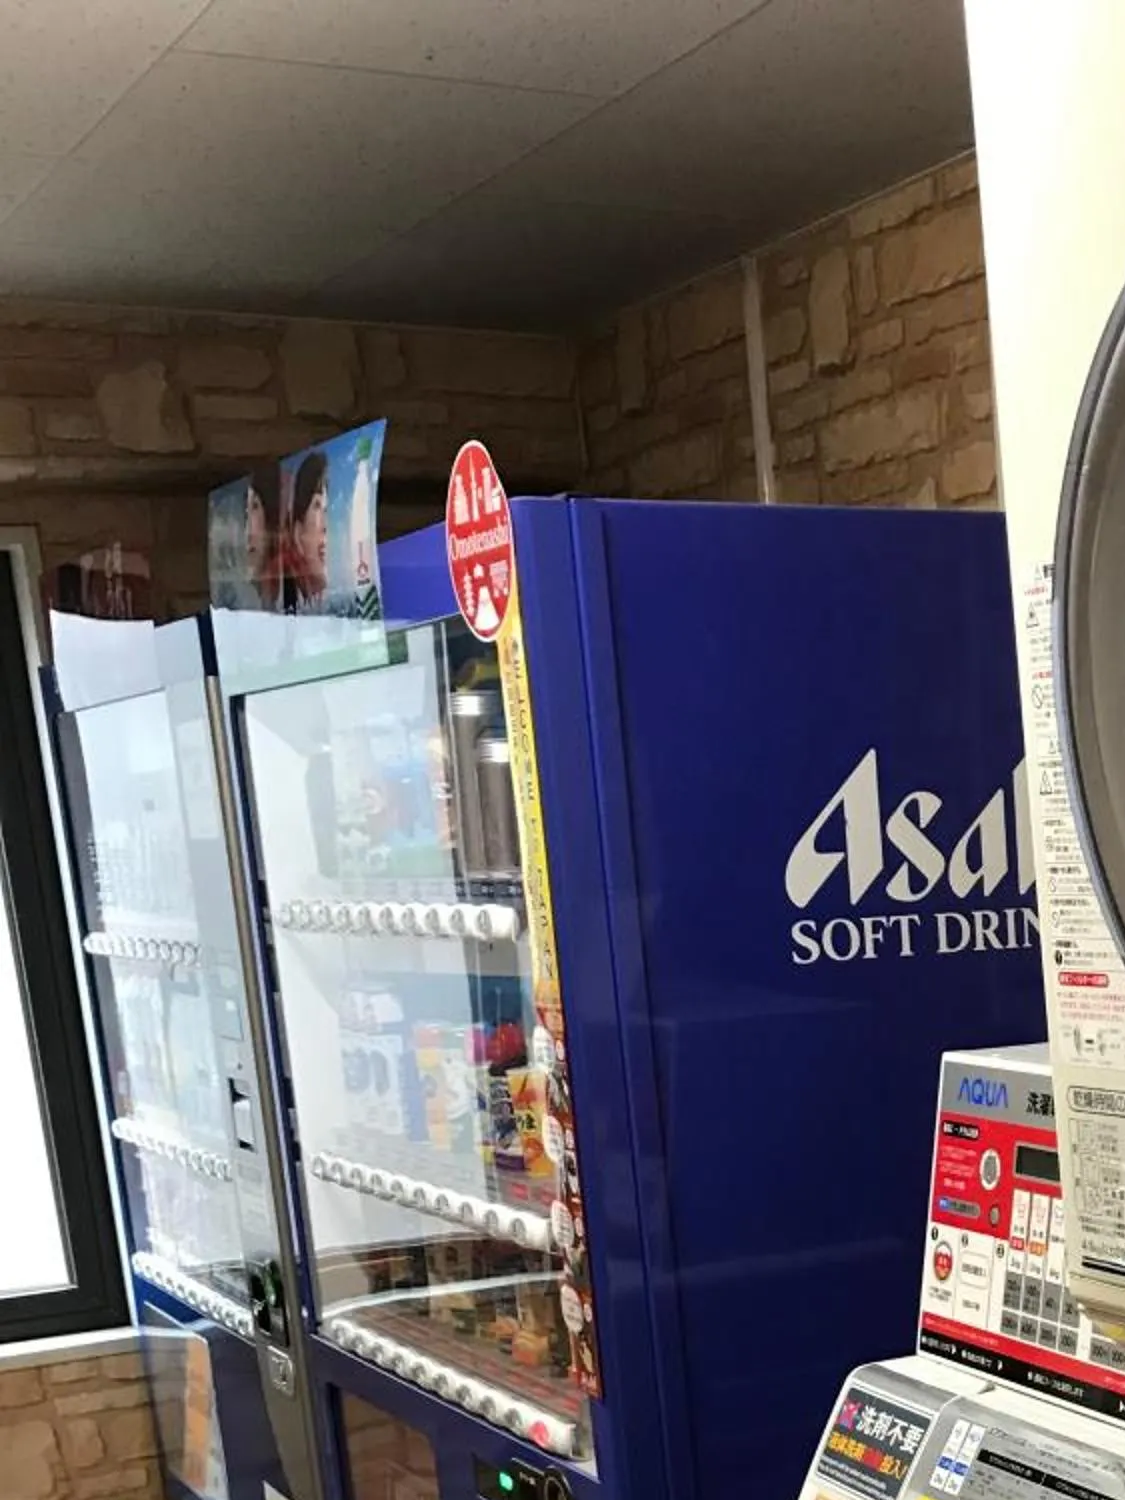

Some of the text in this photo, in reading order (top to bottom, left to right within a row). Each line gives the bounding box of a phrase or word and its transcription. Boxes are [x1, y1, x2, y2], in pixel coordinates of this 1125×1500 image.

[790, 914, 921, 964] SOFT
[959, 1076, 1008, 1108] AQUA
[860, 1404, 925, 1455] 洗剤不要
